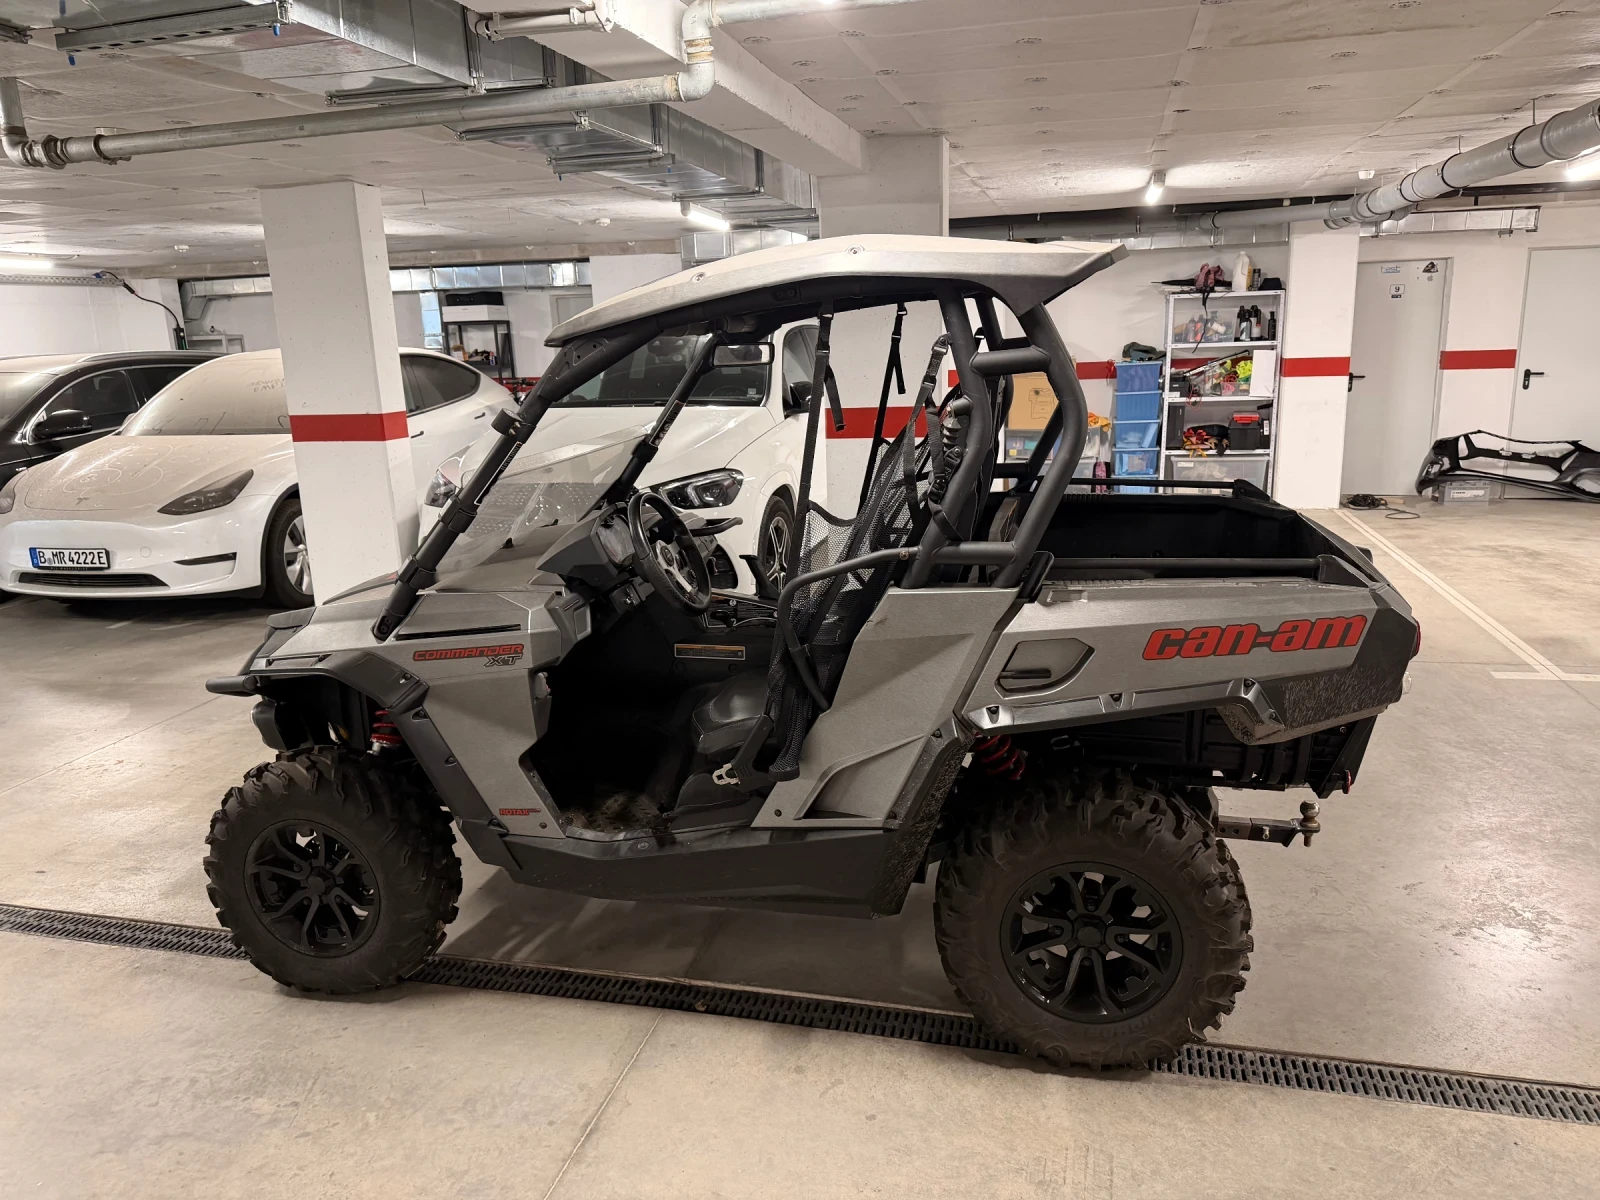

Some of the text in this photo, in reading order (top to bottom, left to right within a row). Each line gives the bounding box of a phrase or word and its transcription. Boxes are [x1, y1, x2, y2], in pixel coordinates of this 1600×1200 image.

[1394, 285, 1400, 293] 9
[38, 550, 47, 564] B
[51, 551, 67, 565] MR
[1142, 614, 1368, 660] can-am
[413, 644, 524, 661] COMMANDER
[484, 654, 523, 668] XT
[499, 808, 530, 816] ROTAX
